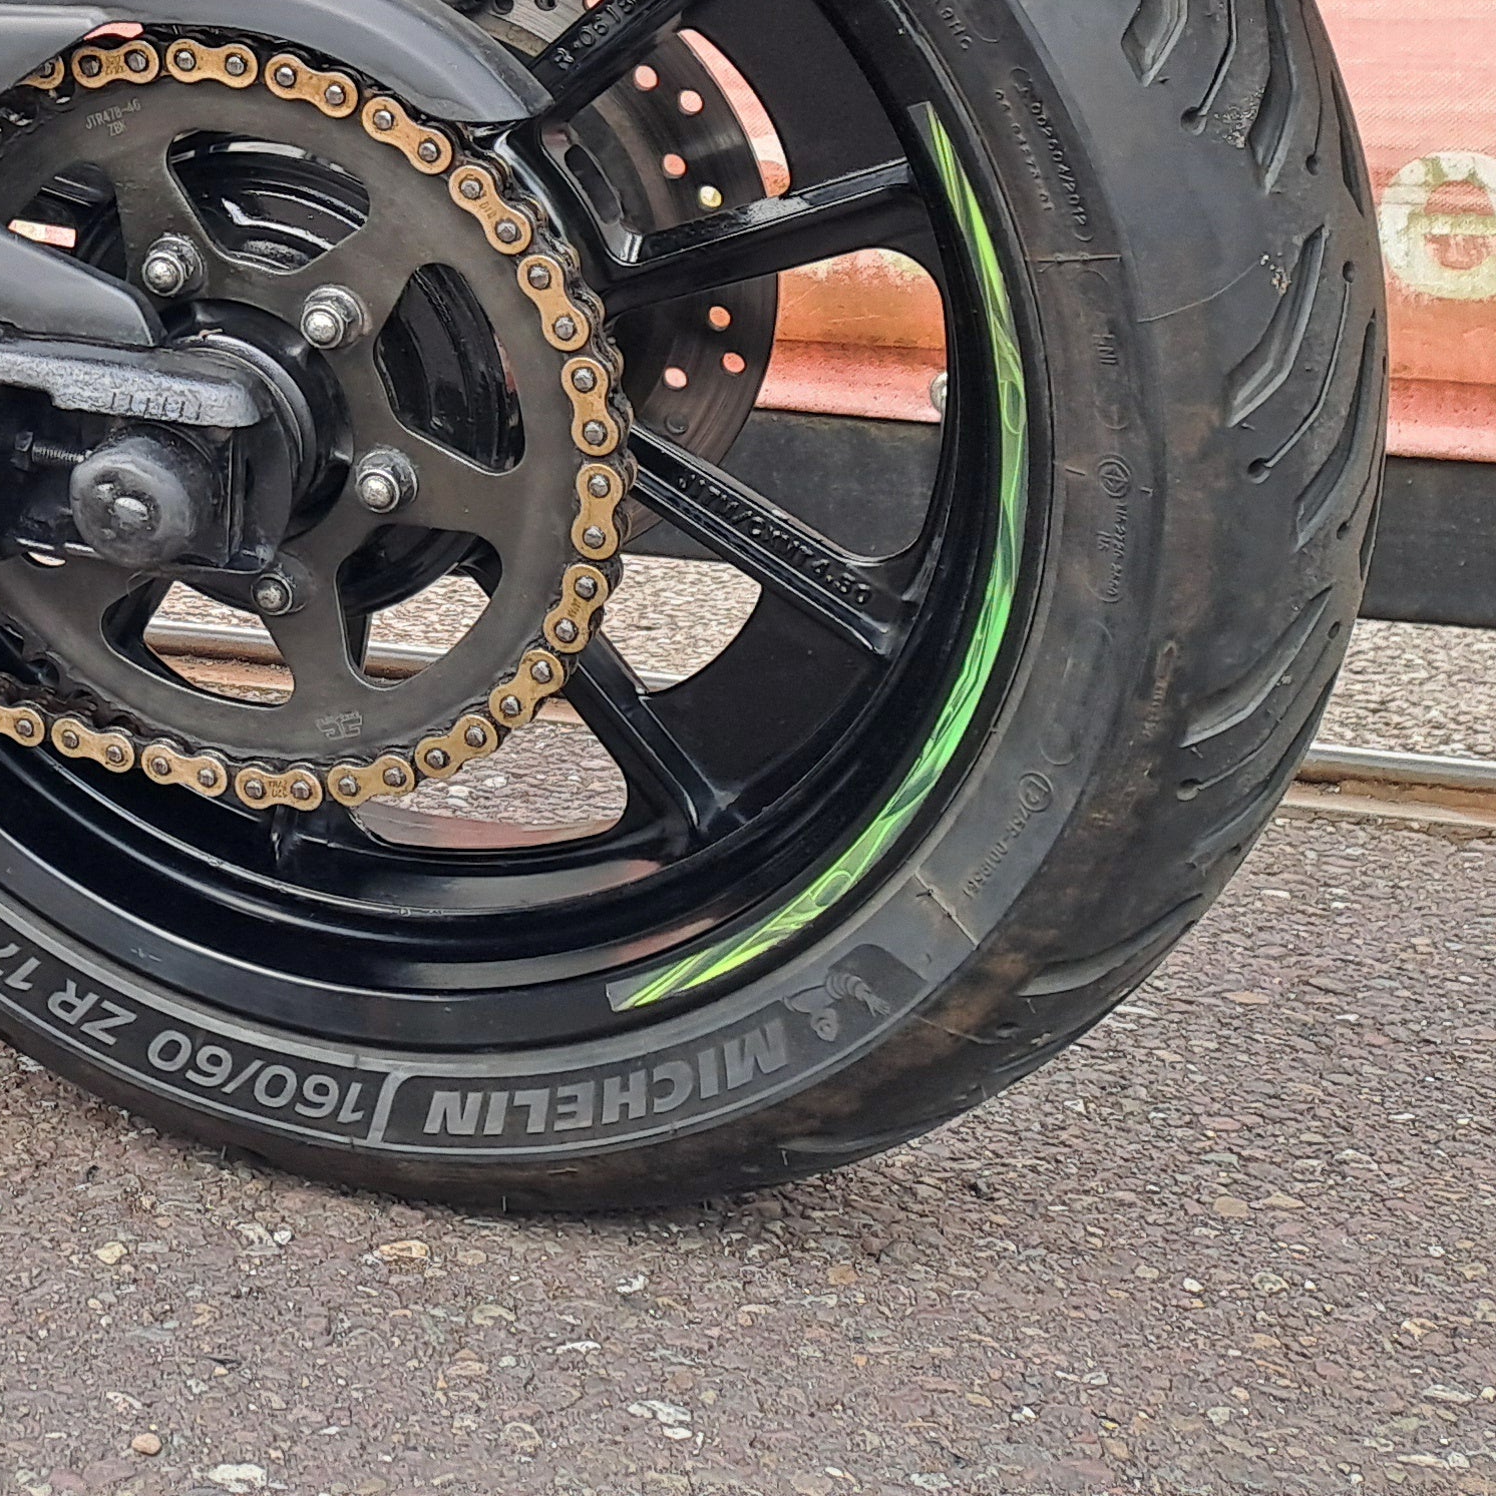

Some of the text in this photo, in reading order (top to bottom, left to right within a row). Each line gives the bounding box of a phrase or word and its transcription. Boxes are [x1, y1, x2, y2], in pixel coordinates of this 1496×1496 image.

[47, 978, 138, 1045] ZR
[147, 1028, 363, 1124] 160/60
[422, 1017, 791, 1136] MICHELIN
